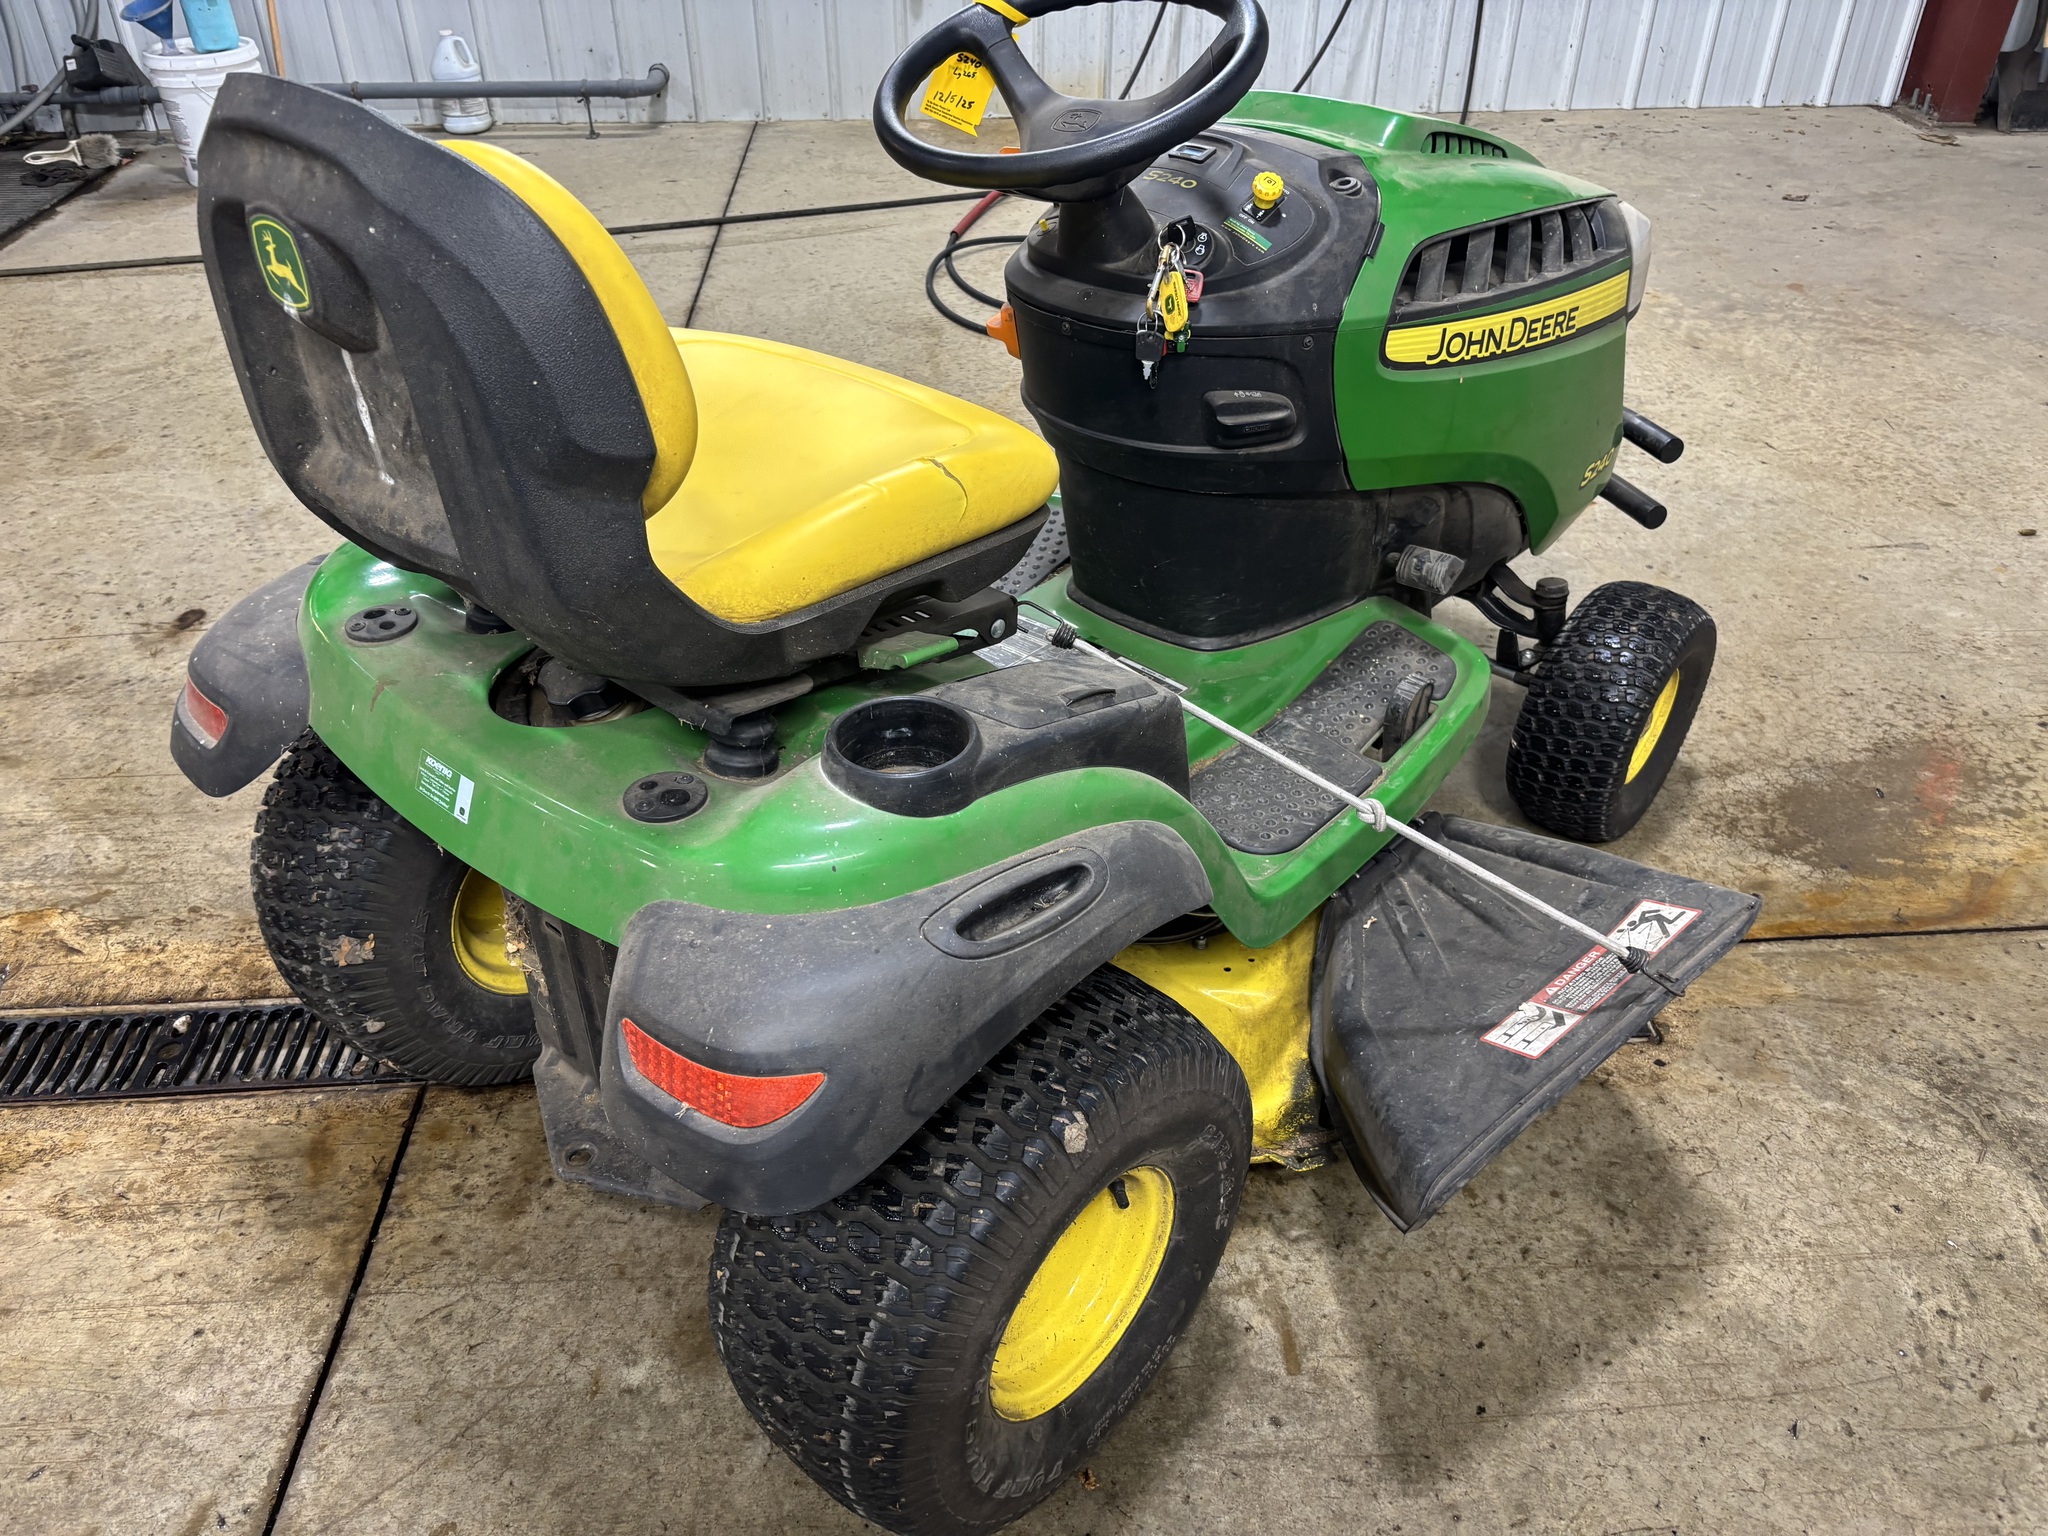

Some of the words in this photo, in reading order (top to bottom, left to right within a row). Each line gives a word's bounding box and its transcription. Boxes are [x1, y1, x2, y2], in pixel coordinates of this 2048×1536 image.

[956, 52, 982, 69] S240
[933, 90, 975, 110] 12/5/25
[1142, 170, 1198, 189] S240
[1426, 326, 1505, 362] JOHN
[1506, 305, 1580, 349] DEERE
[1580, 446, 1616, 488] S240
[1553, 949, 1601, 987] DANGER
